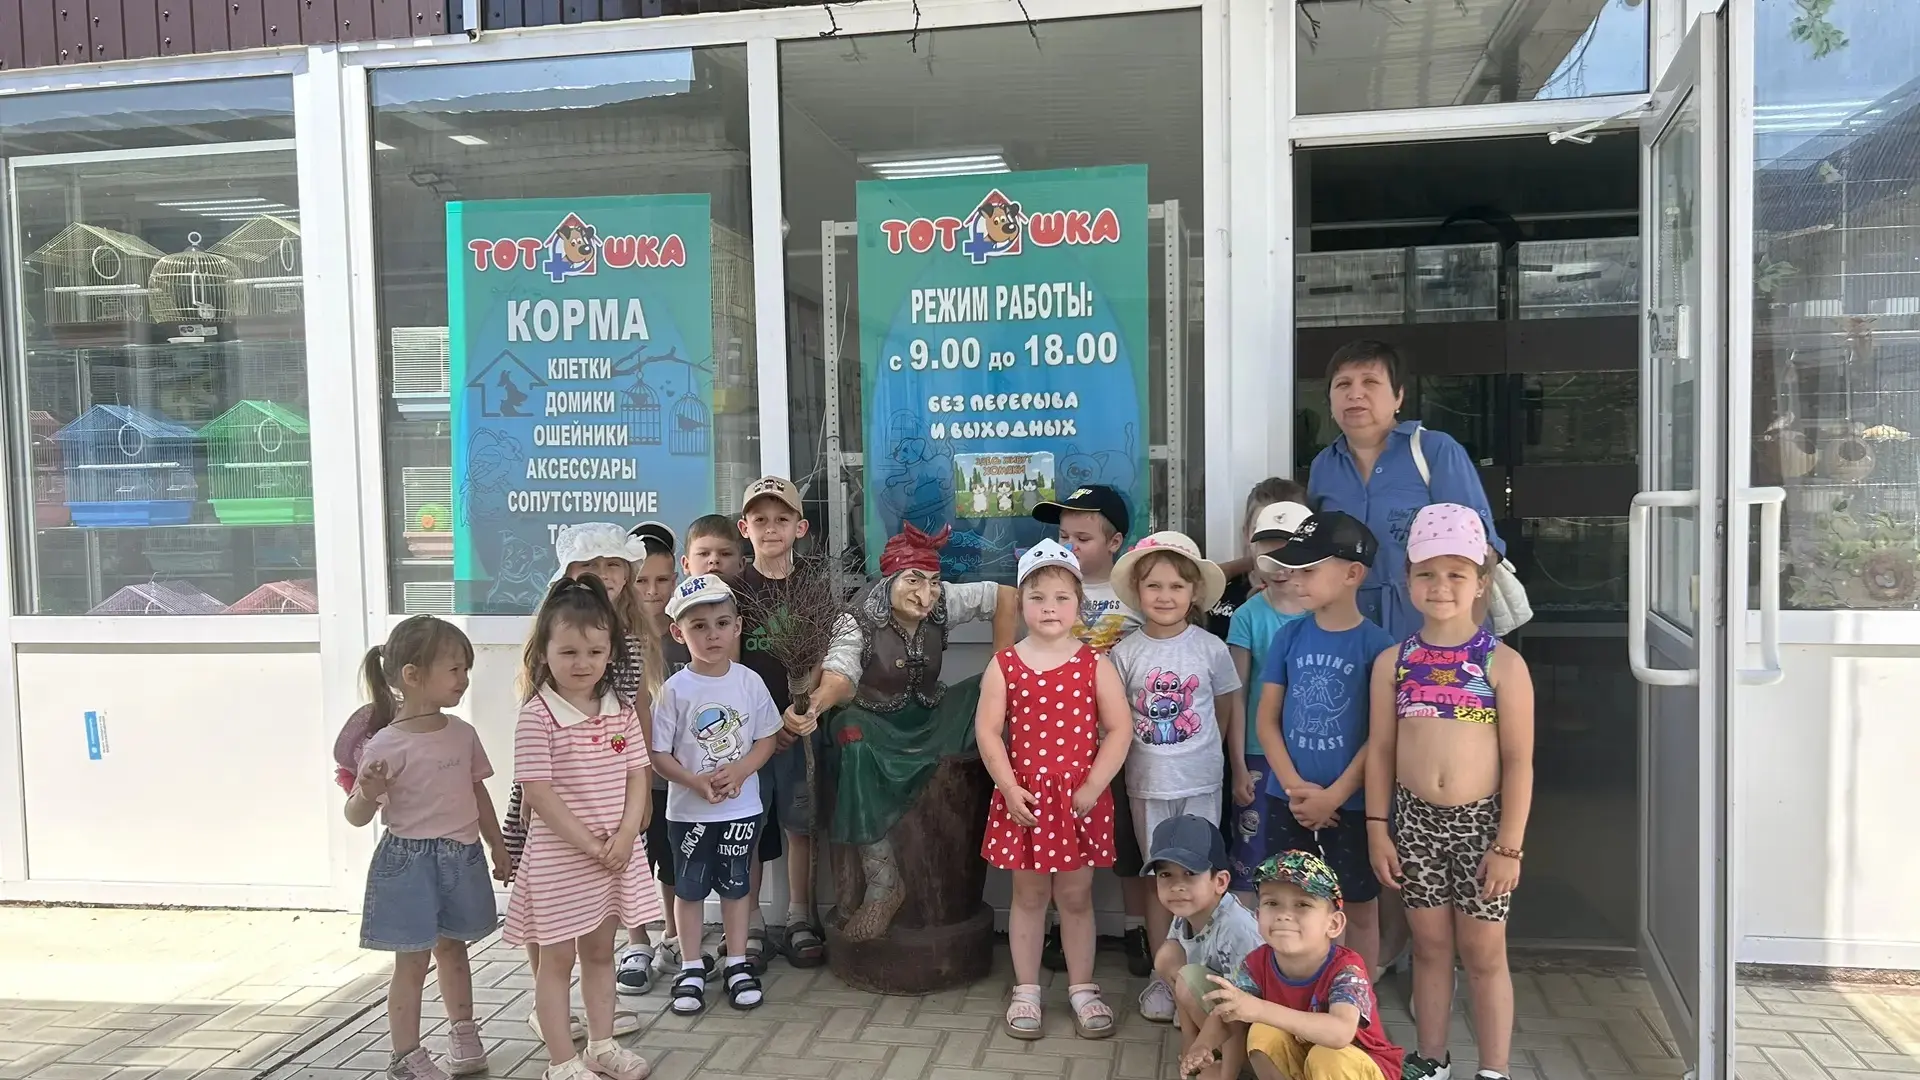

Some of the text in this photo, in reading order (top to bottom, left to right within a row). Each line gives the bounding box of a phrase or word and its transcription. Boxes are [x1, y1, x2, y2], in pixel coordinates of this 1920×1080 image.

[911, 281, 1093, 324] РЕЖИМ РАБОТЫ:
[507, 298, 649, 342] КОРМА
[909, 337, 981, 370] 9.00
[988, 351, 1015, 371] до
[1024, 331, 1118, 366] 18.00
[547, 357, 612, 380] КЛЕТКИ
[545, 391, 615, 416] ДОМИКИ
[928, 391, 1078, 413] БЕЗ ПЕРЕРЫВА
[533, 421, 628, 446] ОШЕЙНИКИ
[930, 419, 1077, 439] И ВЫХОДНЫХ
[526, 458, 637, 479] АКСЕССУАРЫ
[507, 490, 658, 516] СОПУТСТВУЮЩИЕ
[1296, 653, 1355, 675] HAVING
[1298, 735, 1344, 751] BLAST
